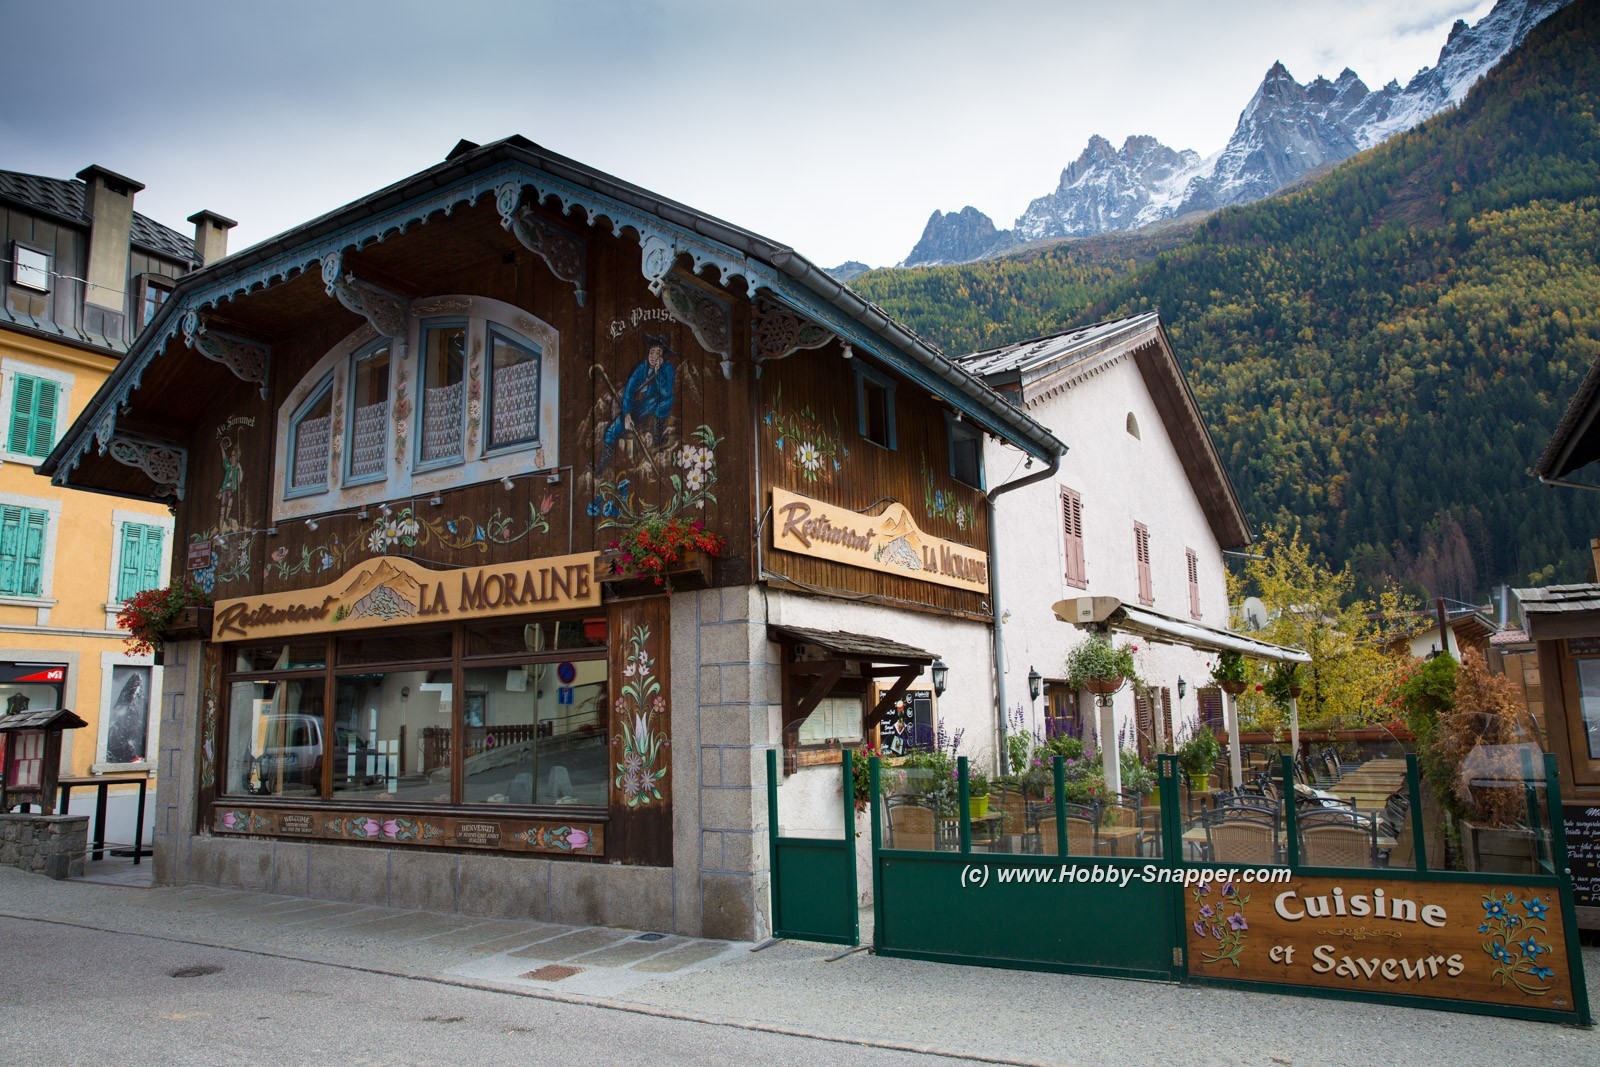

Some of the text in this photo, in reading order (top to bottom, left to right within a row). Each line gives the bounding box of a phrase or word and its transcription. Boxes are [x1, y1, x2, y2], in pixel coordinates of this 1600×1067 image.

[610, 320, 626, 340] La
[215, 414, 256, 439] Au Sommet
[778, 501, 987, 585] Restaurant LA MORAINE
[215, 562, 591, 638] Restaurant LA MORAINE
[283, 815, 309, 823] WELCOME
[1274, 886, 1447, 927] Cuisine
[1269, 944, 1465, 981] et Saveurs
